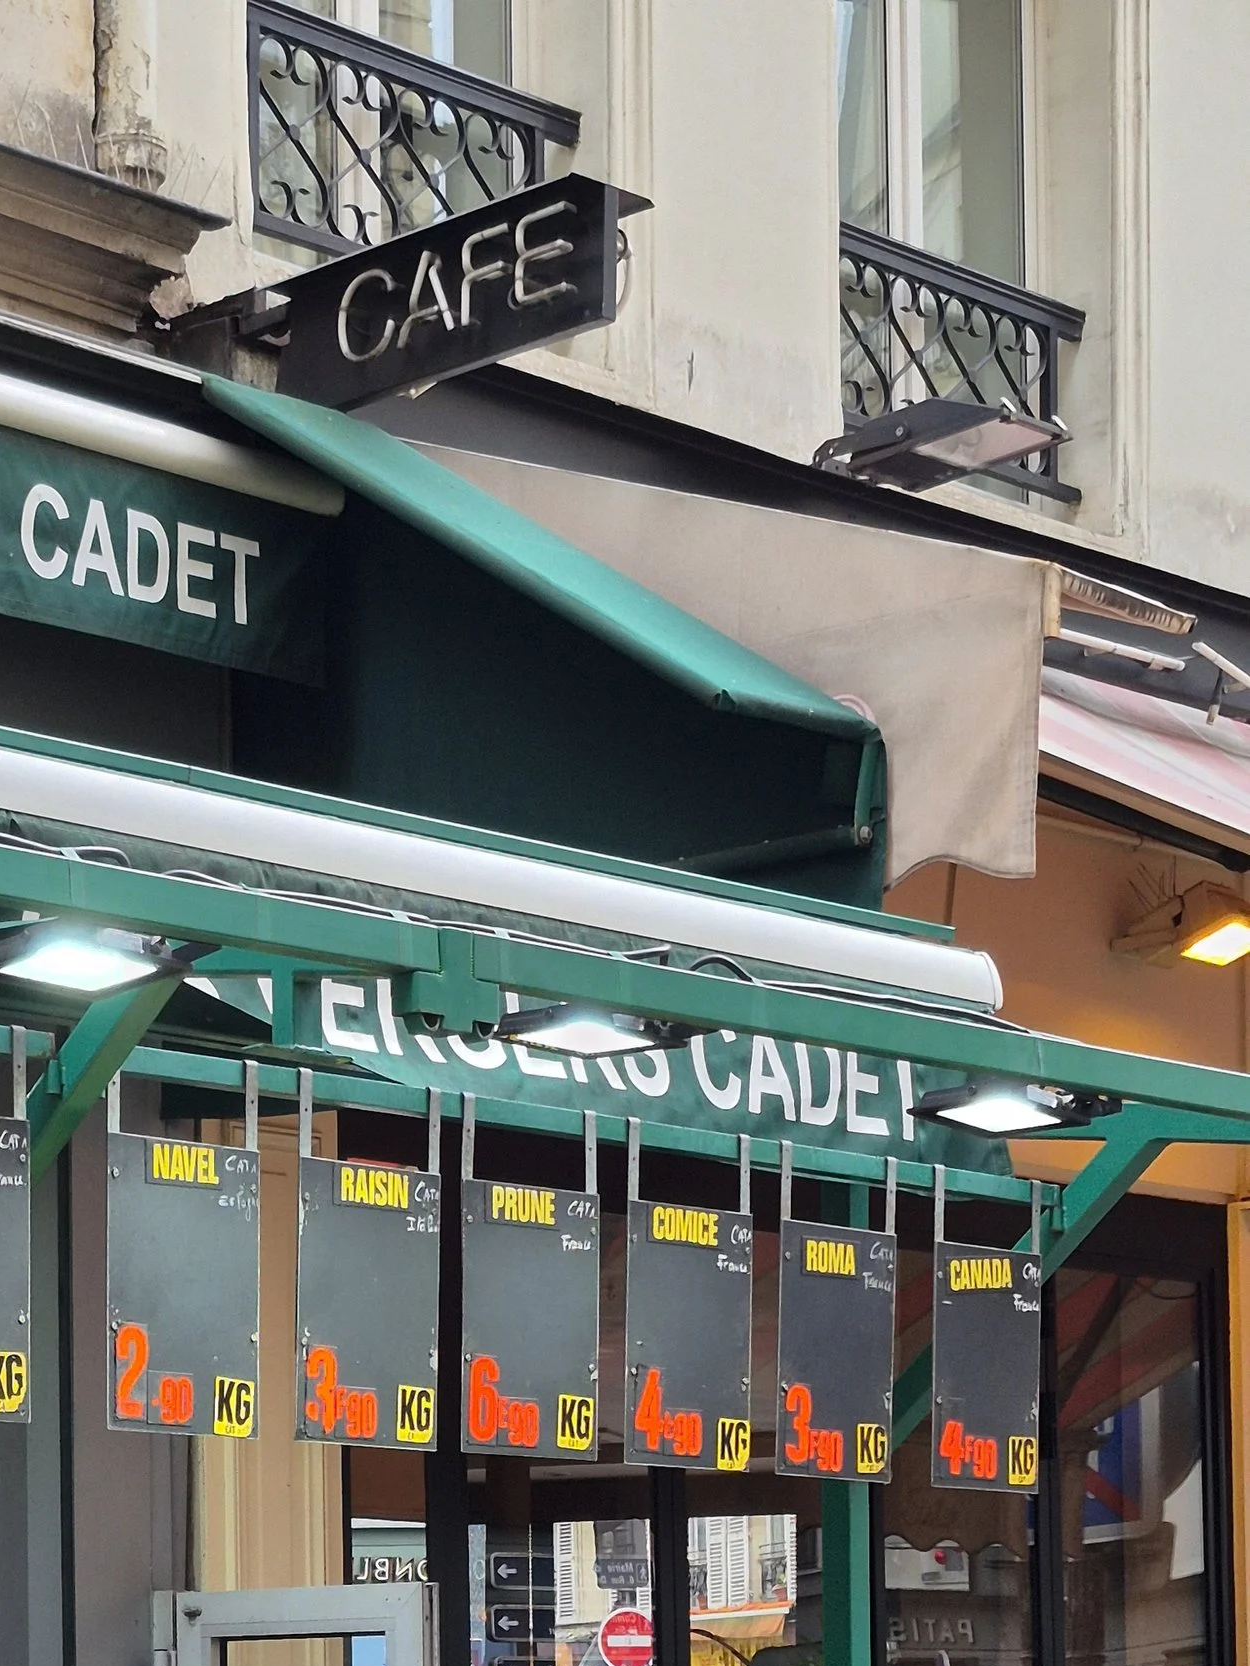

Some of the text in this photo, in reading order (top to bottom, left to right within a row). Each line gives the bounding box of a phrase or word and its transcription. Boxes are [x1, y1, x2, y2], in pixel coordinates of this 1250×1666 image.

[337, 200, 579, 362] CAFE
[20, 483, 261, 626] CADET
[152, 1143, 220, 1185] NAVEL
[341, 1166, 409, 1210] RAISIN
[491, 1184, 556, 1226] PRUNE
[652, 1206, 719, 1247] COMICE
[805, 1239, 857, 1276] ROMA
[949, 1258, 1013, 1292] CANADA
[217, 1378, 252, 1427] KG
[399, 1387, 432, 1433] KG
[560, 1397, 591, 1441] KG
[720, 1420, 748, 1463] KG
[859, 1424, 887, 1465] KG
[1010, 1438, 1035, 1478] KG
